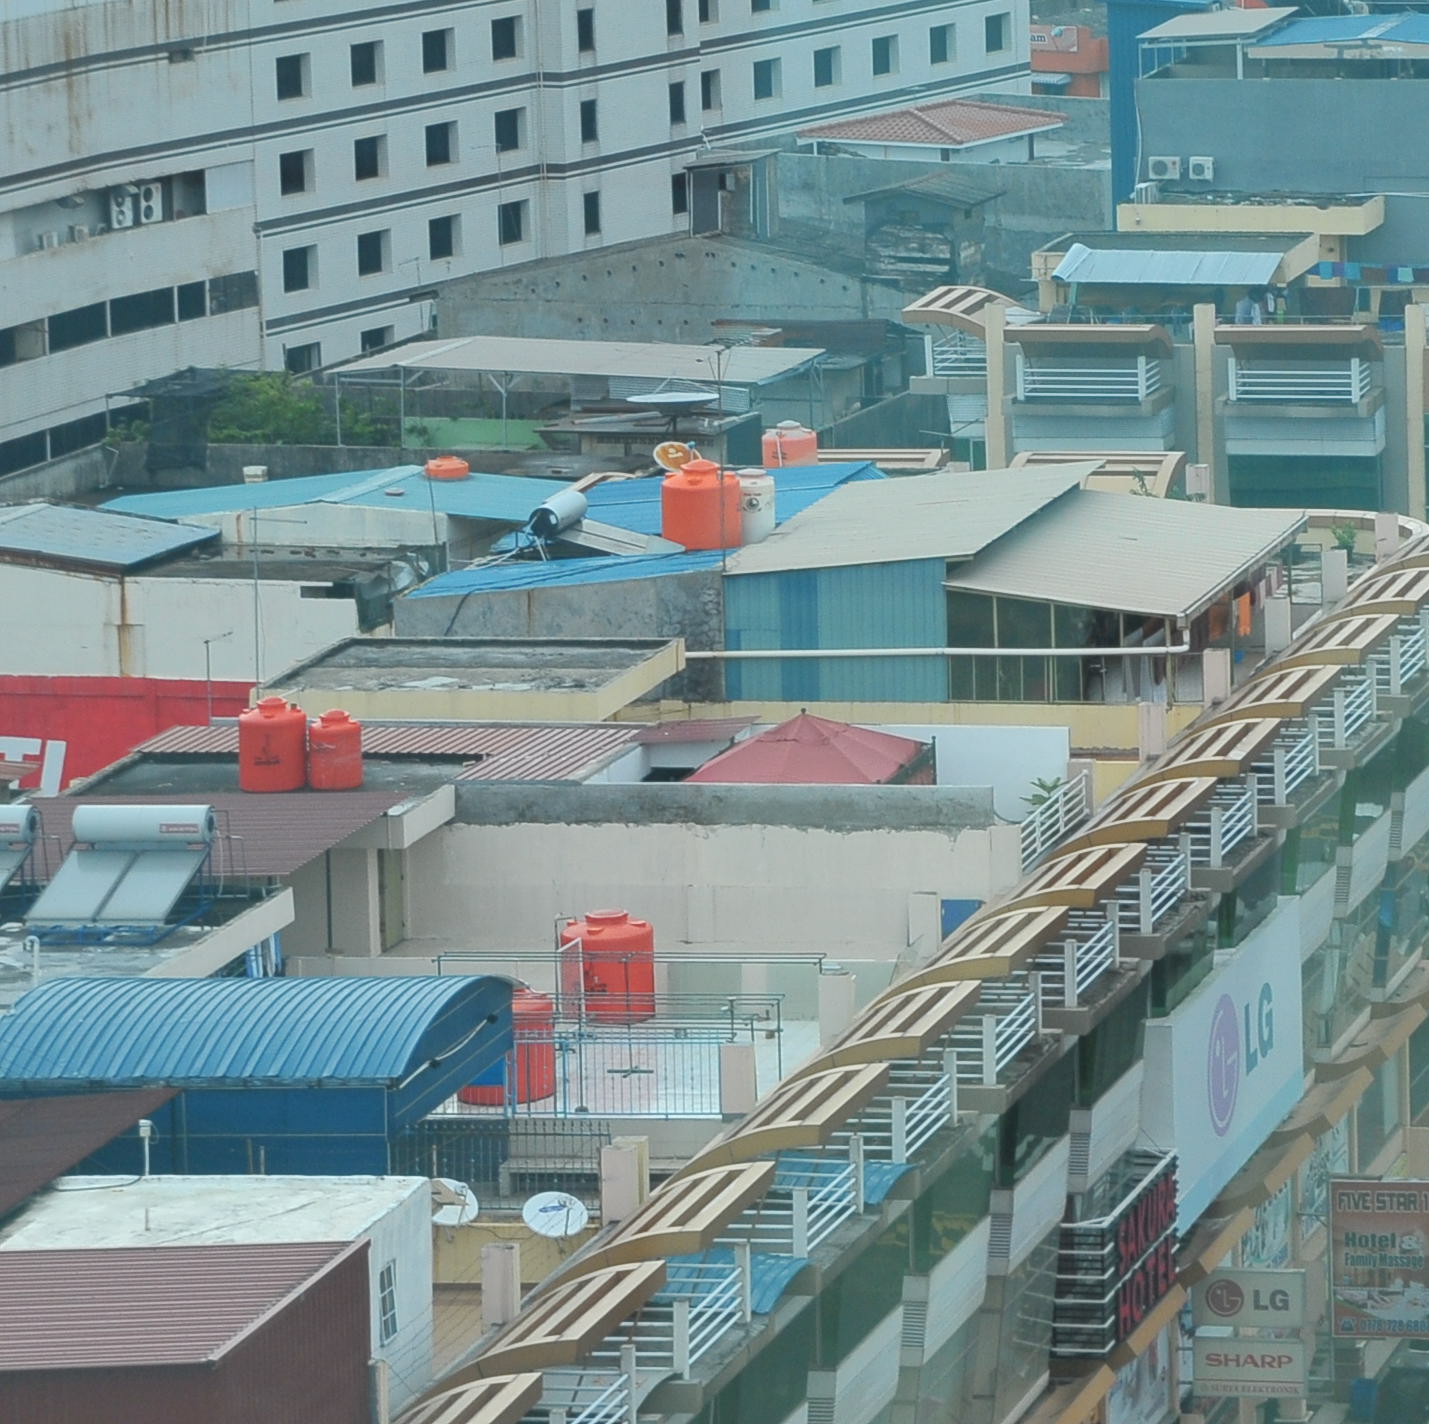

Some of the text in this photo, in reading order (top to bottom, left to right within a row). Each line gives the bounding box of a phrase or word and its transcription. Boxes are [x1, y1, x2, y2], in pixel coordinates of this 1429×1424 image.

[1030, 34, 1047, 43] am
[1244, 982, 1274, 1076] LG
[1338, 1191, 1429, 1213] FIVE STAR 1
[1119, 1169, 1177, 1276] SAKURA
[1344, 1232, 1396, 1249] Hotel
[1345, 1252, 1378, 1269] Family
[1119, 1234, 1177, 1343] HOTEL
[1253, 1289, 1290, 1311] LG
[1205, 1353, 1293, 1368] SHARP
